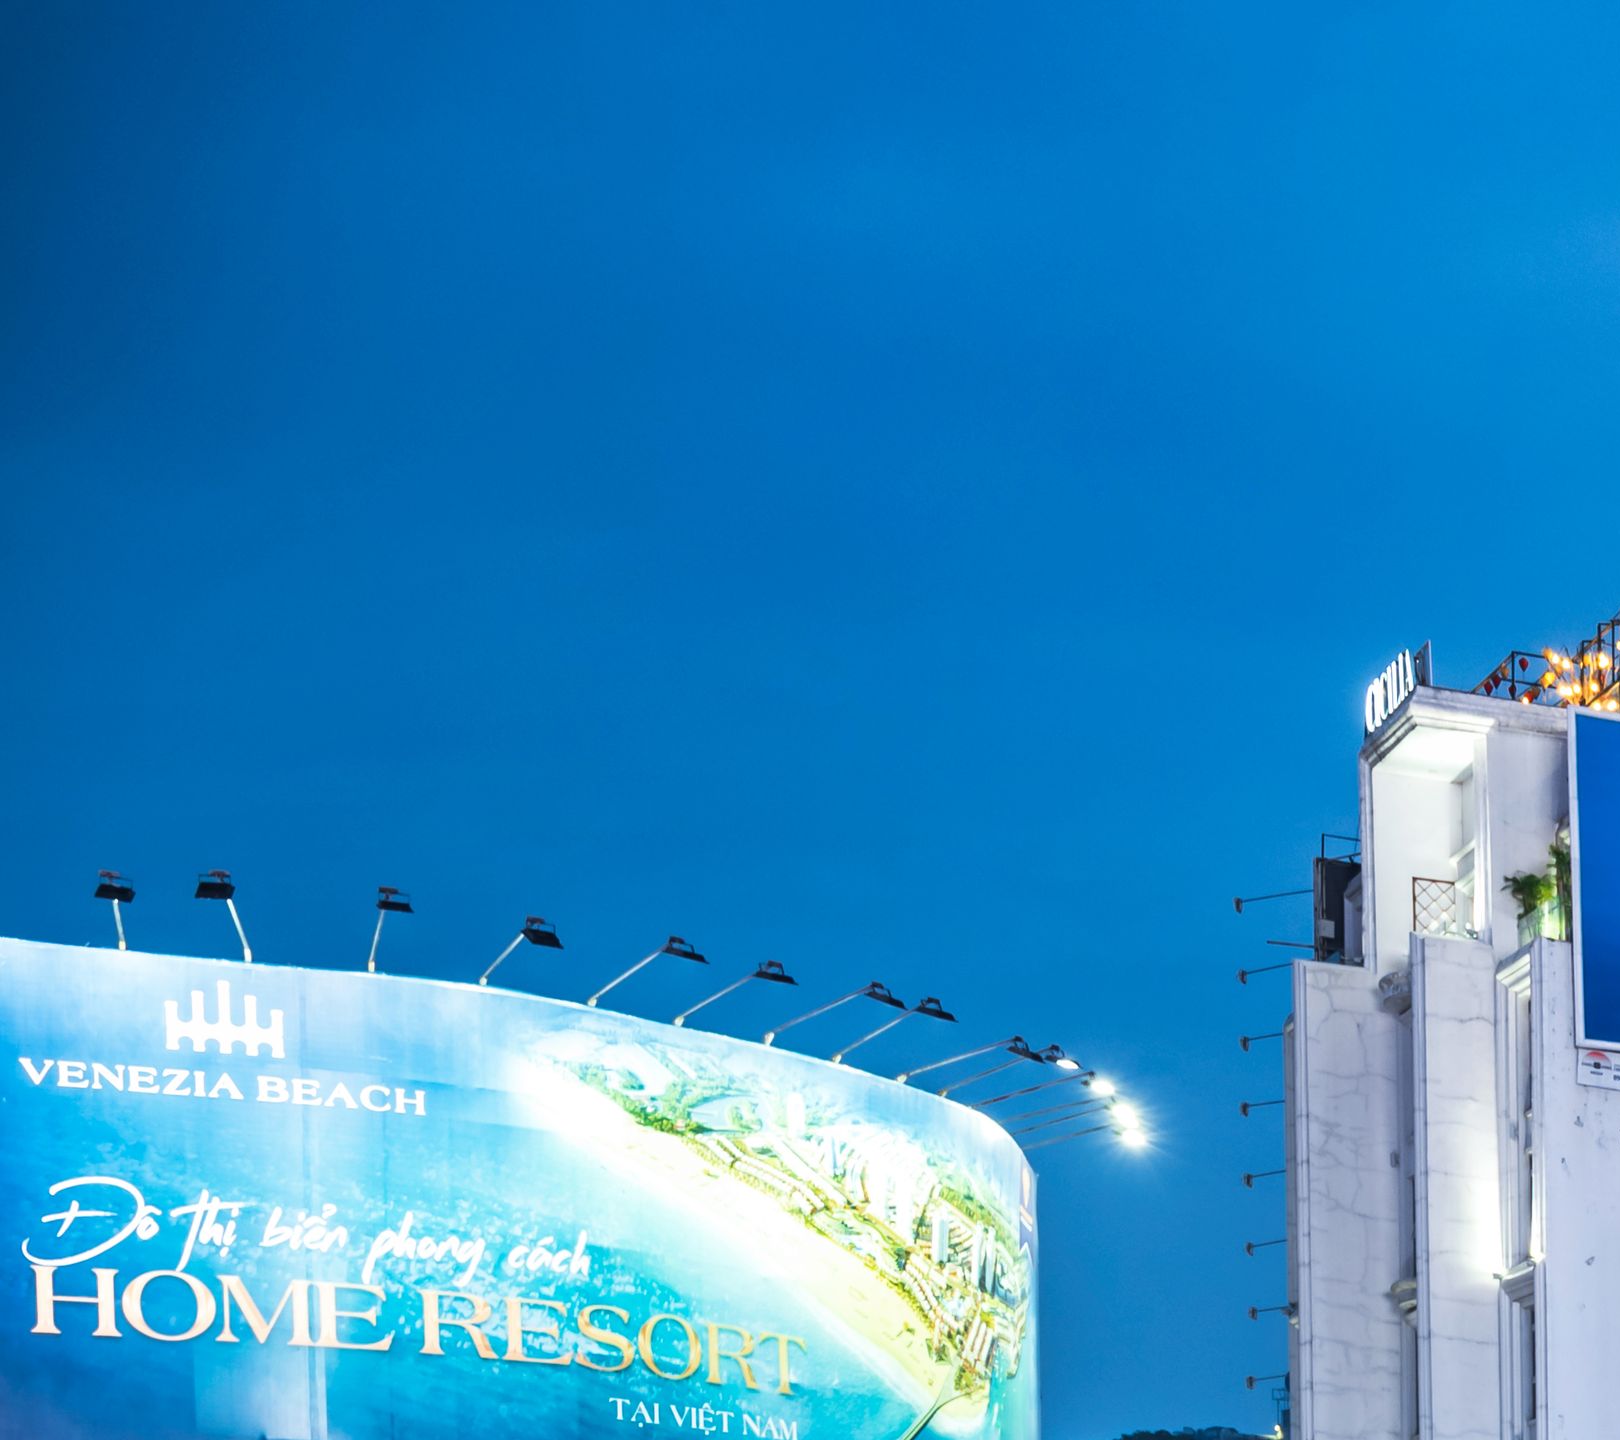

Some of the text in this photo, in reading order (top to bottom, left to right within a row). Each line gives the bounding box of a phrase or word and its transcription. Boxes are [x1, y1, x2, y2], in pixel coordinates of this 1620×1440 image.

[18, 1057, 428, 1117] VENEZIA BEACH
[29, 1262, 808, 1397] HOME RESORT
[609, 1396, 661, 1430] TẠI
[669, 1401, 736, 1436] VIỆT
